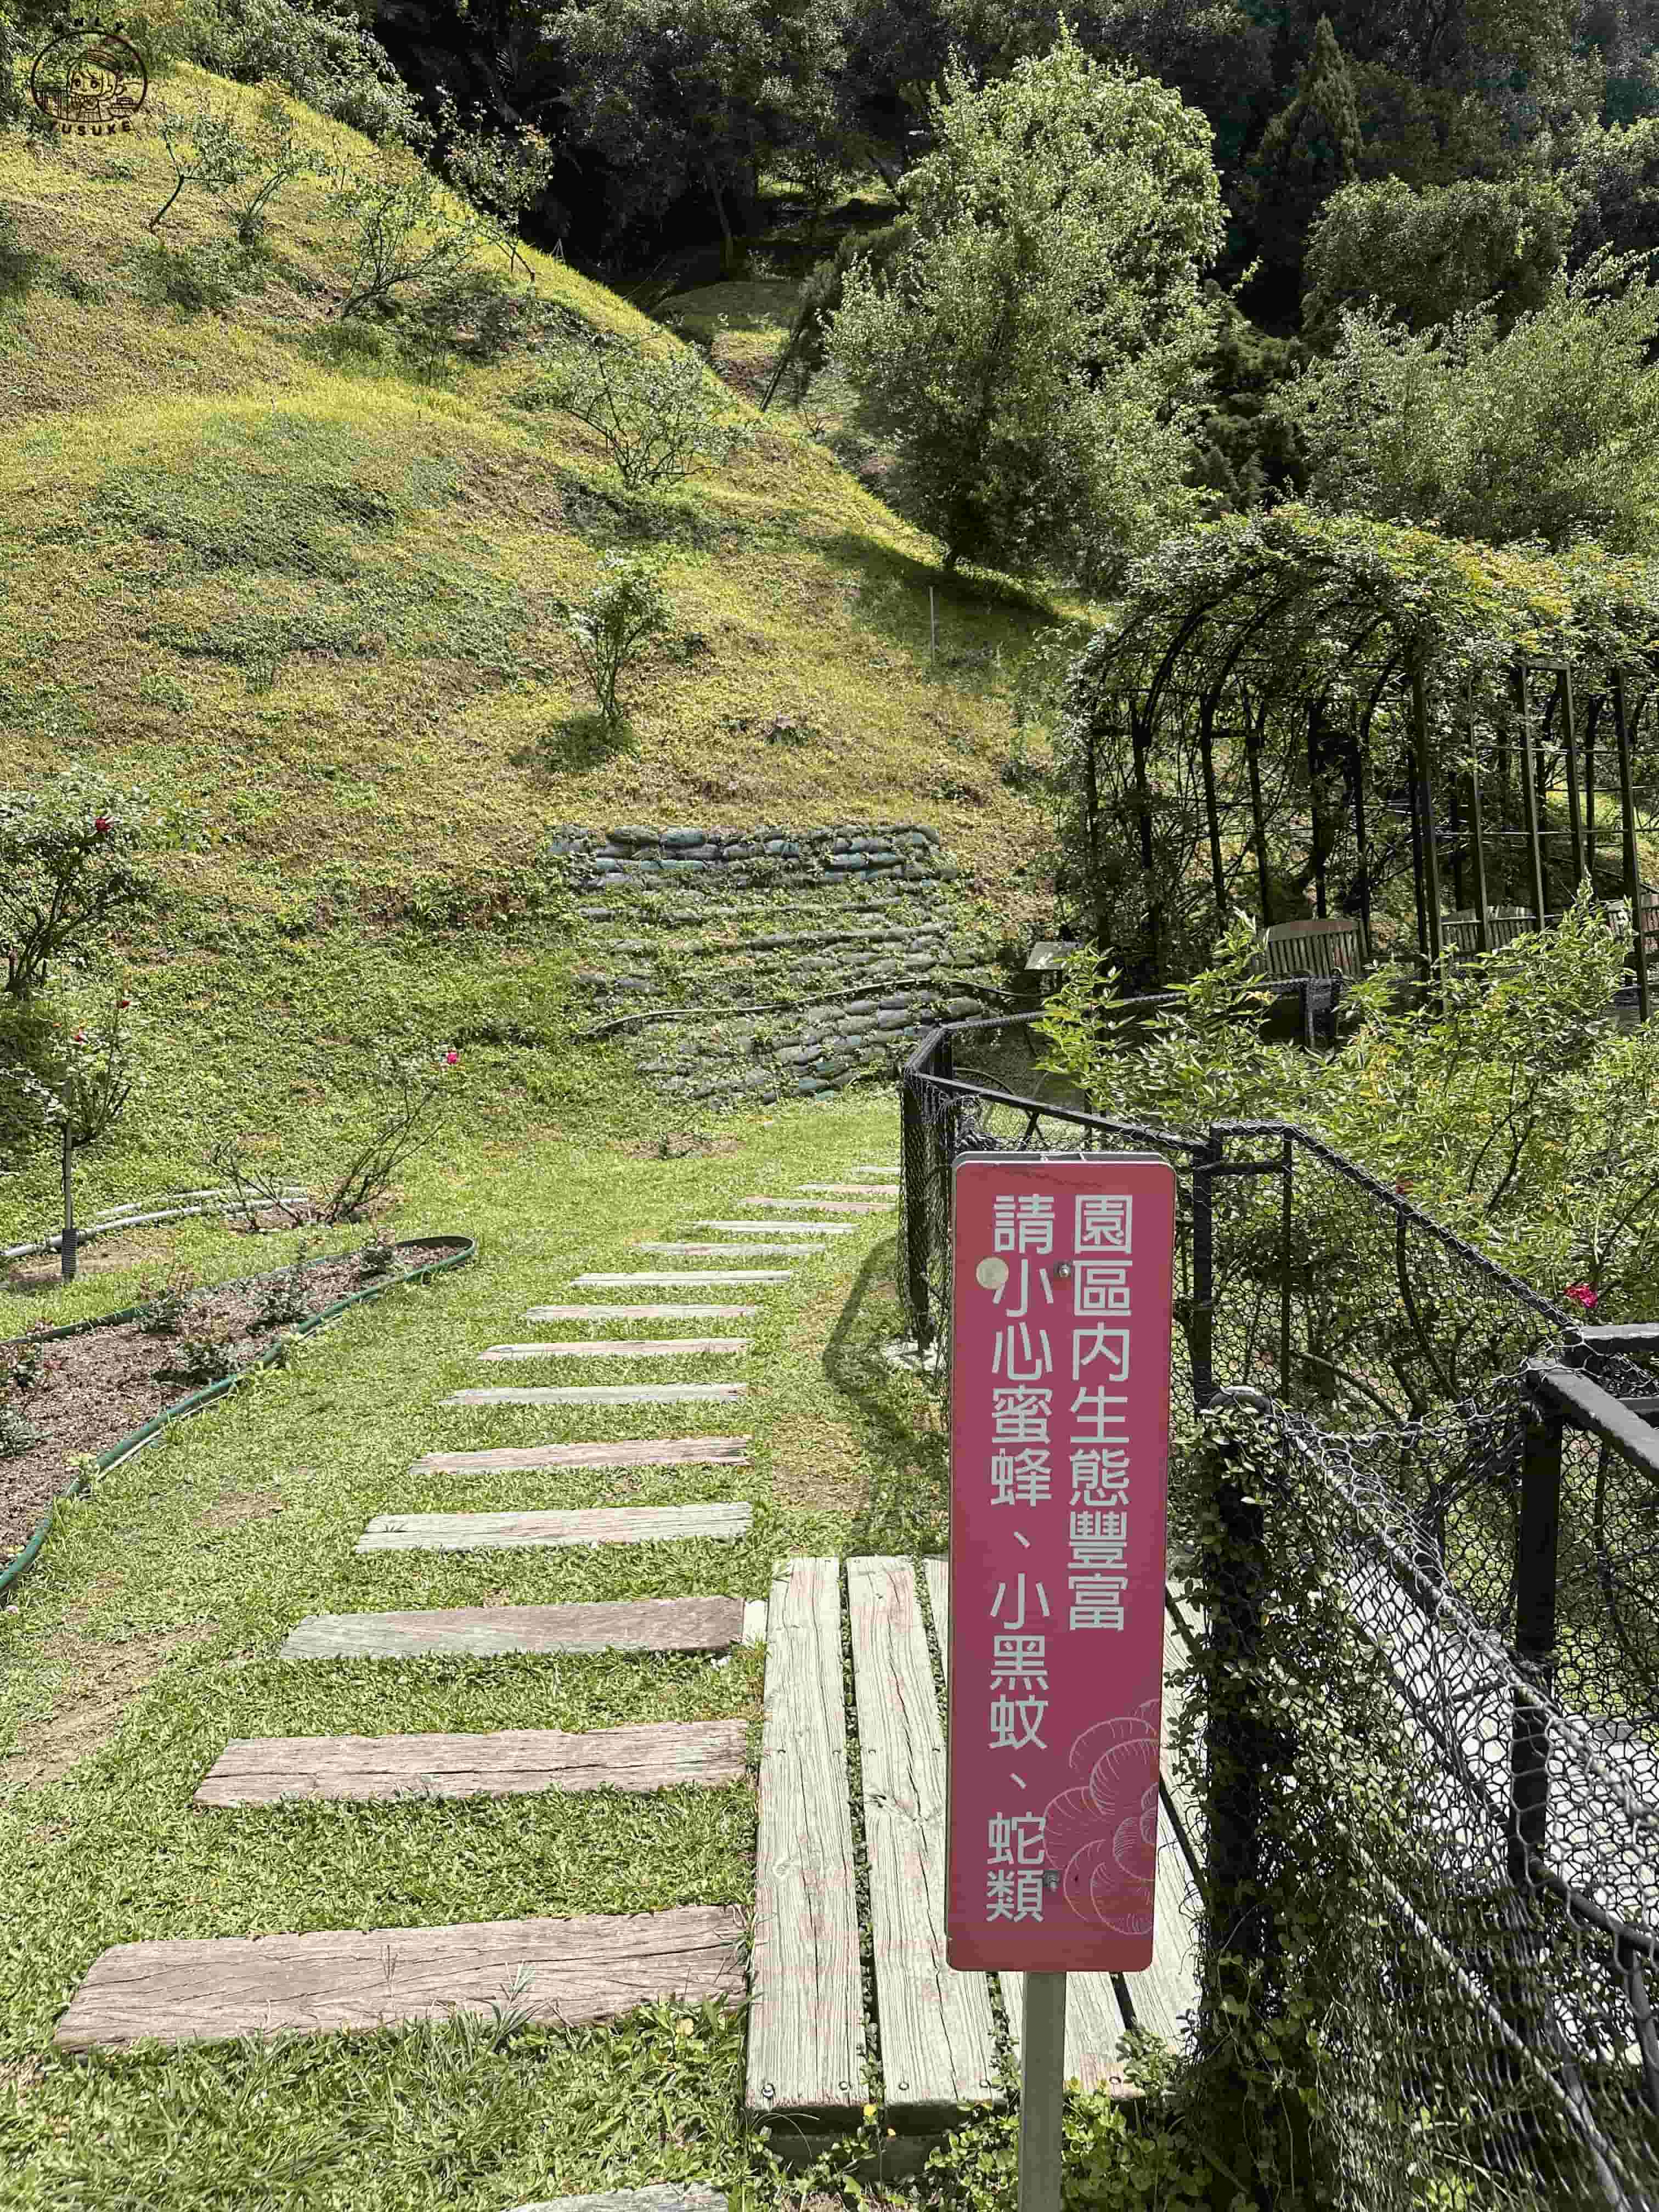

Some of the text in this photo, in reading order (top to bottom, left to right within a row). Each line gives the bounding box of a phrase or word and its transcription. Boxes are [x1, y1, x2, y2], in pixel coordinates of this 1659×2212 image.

[986, 1193, 1055, 1922] 請小心蜜蜂、小黑蚊、蛇類
